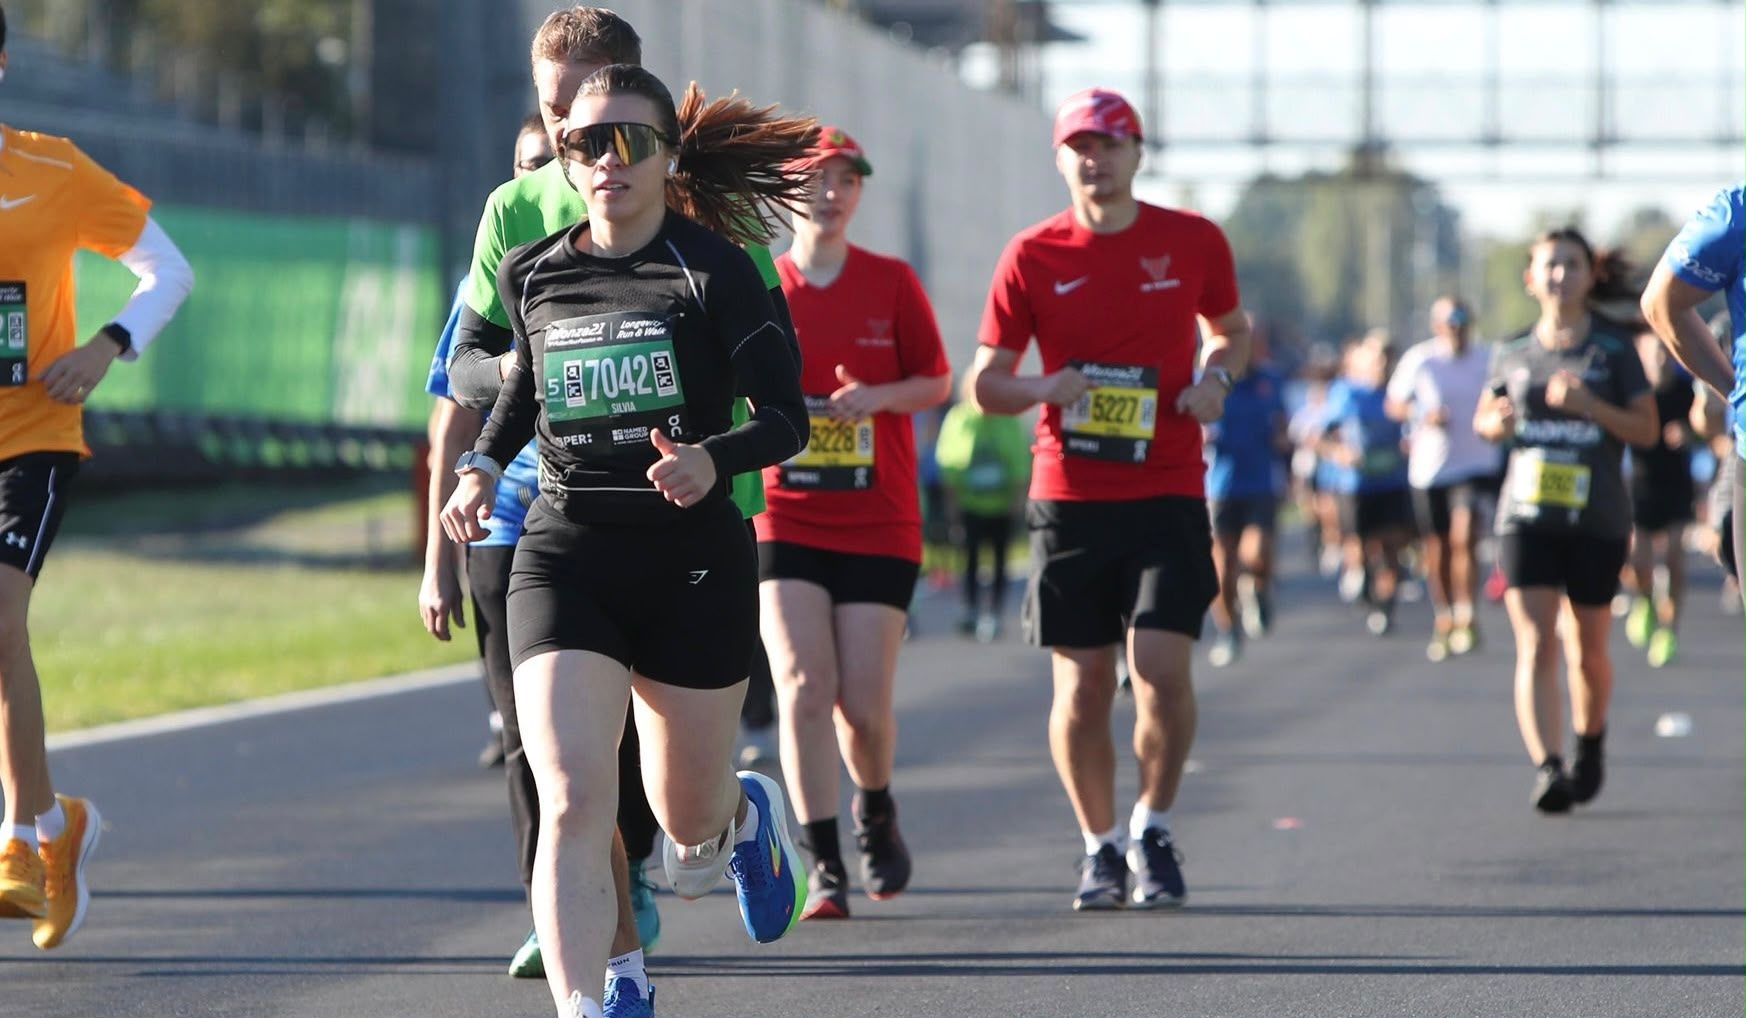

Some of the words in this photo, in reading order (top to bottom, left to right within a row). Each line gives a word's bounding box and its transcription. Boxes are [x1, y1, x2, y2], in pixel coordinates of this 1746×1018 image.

[616, 330, 633, 339] Run
[634, 329, 642, 337] &
[644, 327, 667, 337] Walk
[585, 354, 653, 400] 7042
[547, 378, 560, 396] 5
[611, 401, 637, 414] SILVIA
[1092, 394, 1139, 424] 5227
[624, 432, 649, 440] GROUP
